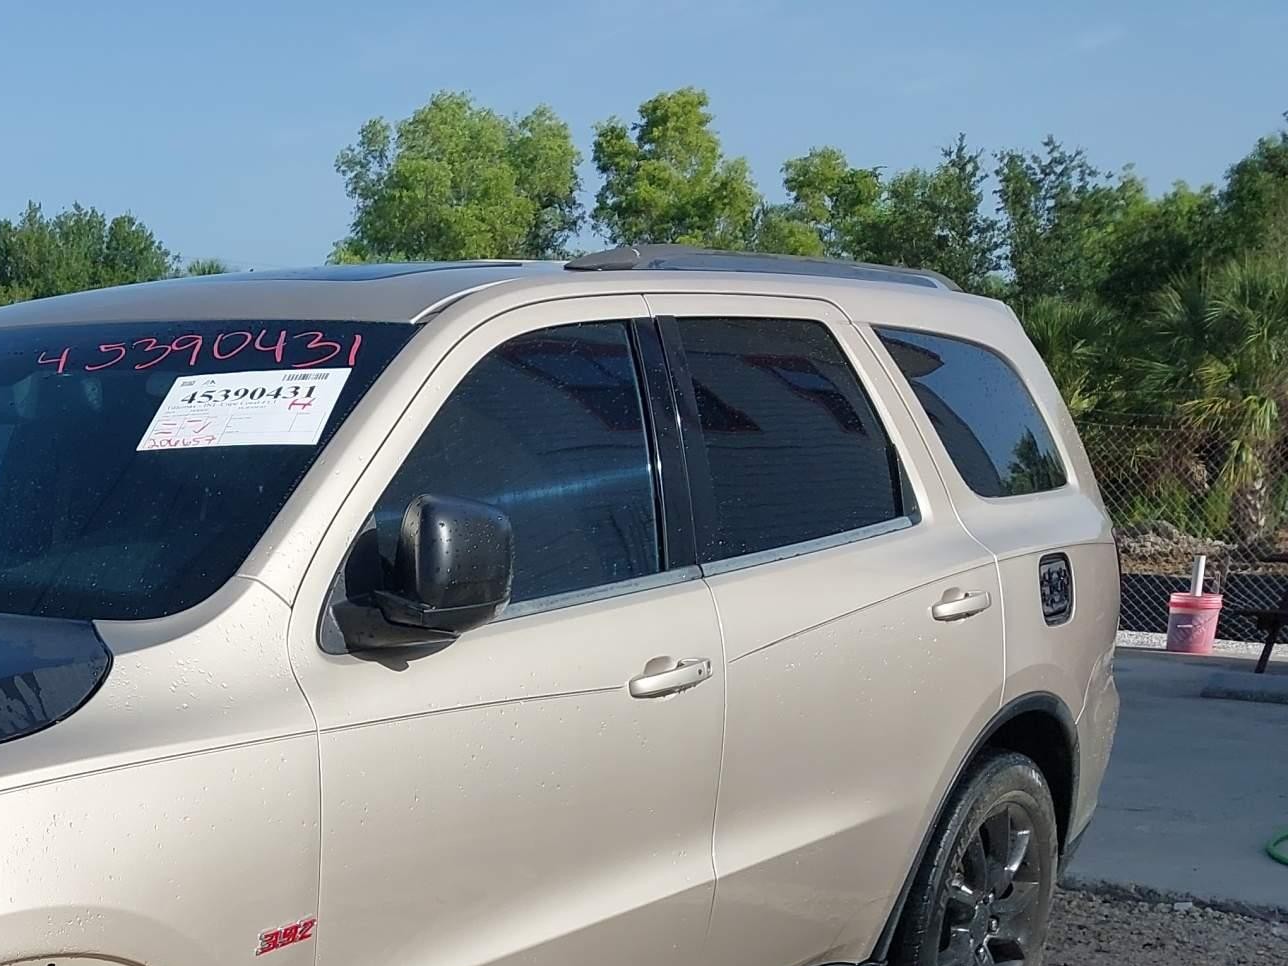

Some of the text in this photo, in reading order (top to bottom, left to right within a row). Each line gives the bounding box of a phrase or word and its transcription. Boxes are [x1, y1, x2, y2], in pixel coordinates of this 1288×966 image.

[37, 329, 362, 373] 45390431
[181, 385, 316, 404] 45390431
[255, 916, 317, 956] 392
